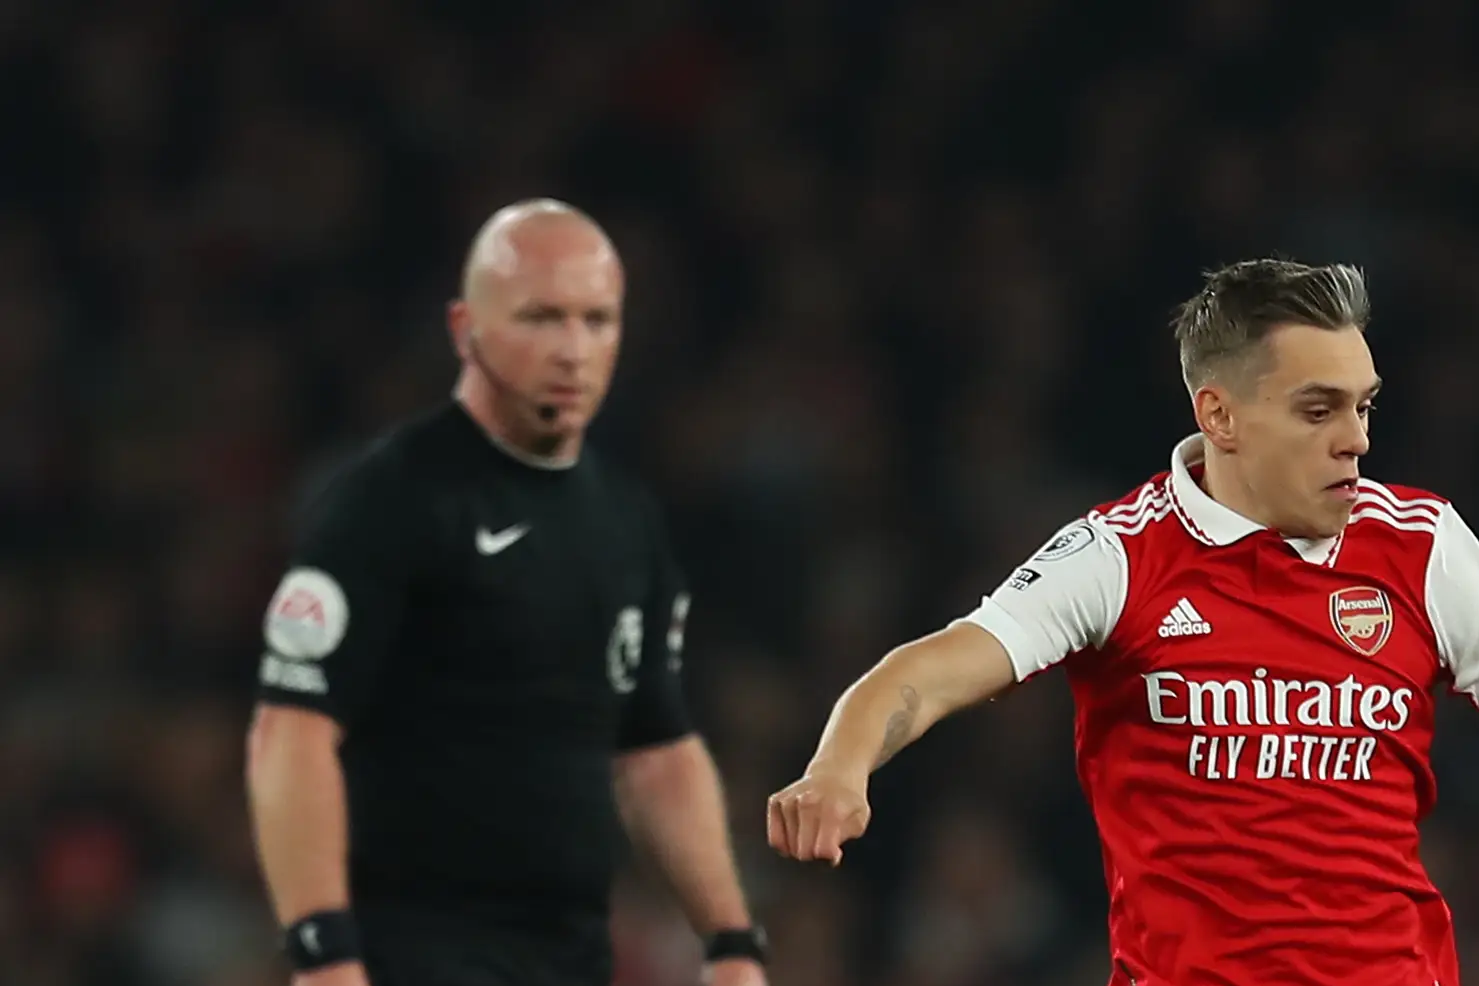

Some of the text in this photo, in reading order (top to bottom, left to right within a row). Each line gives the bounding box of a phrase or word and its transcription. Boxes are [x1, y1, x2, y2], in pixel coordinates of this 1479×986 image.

[1338, 596, 1383, 611] Arsenal
[1158, 621, 1212, 638] adidas
[1140, 667, 1413, 732] Emirates
[1188, 734, 1377, 781] FLY BETTER
